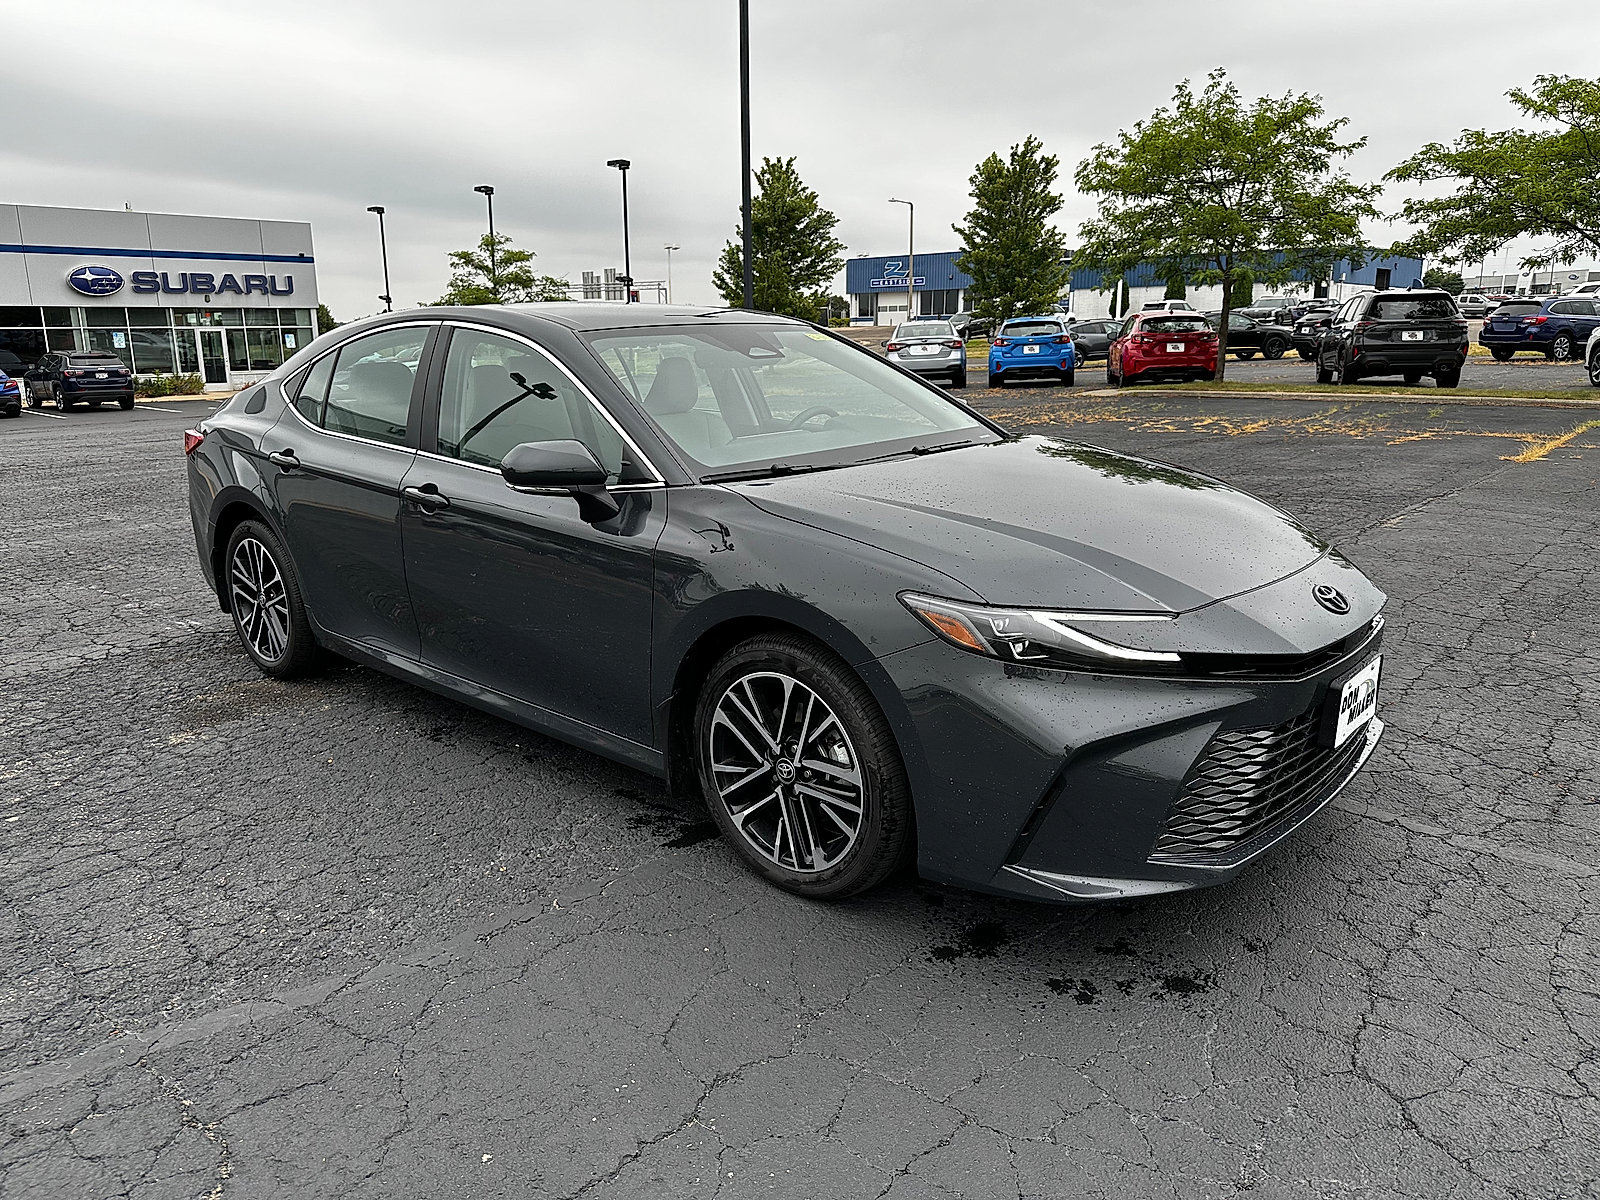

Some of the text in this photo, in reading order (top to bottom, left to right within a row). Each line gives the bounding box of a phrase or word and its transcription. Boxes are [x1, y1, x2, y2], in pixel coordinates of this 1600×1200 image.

[131, 270, 294, 296] SUBARU
[884, 261, 910, 278] Z
[1341, 686, 1360, 714] DON
[1347, 688, 1375, 725] MILLER
